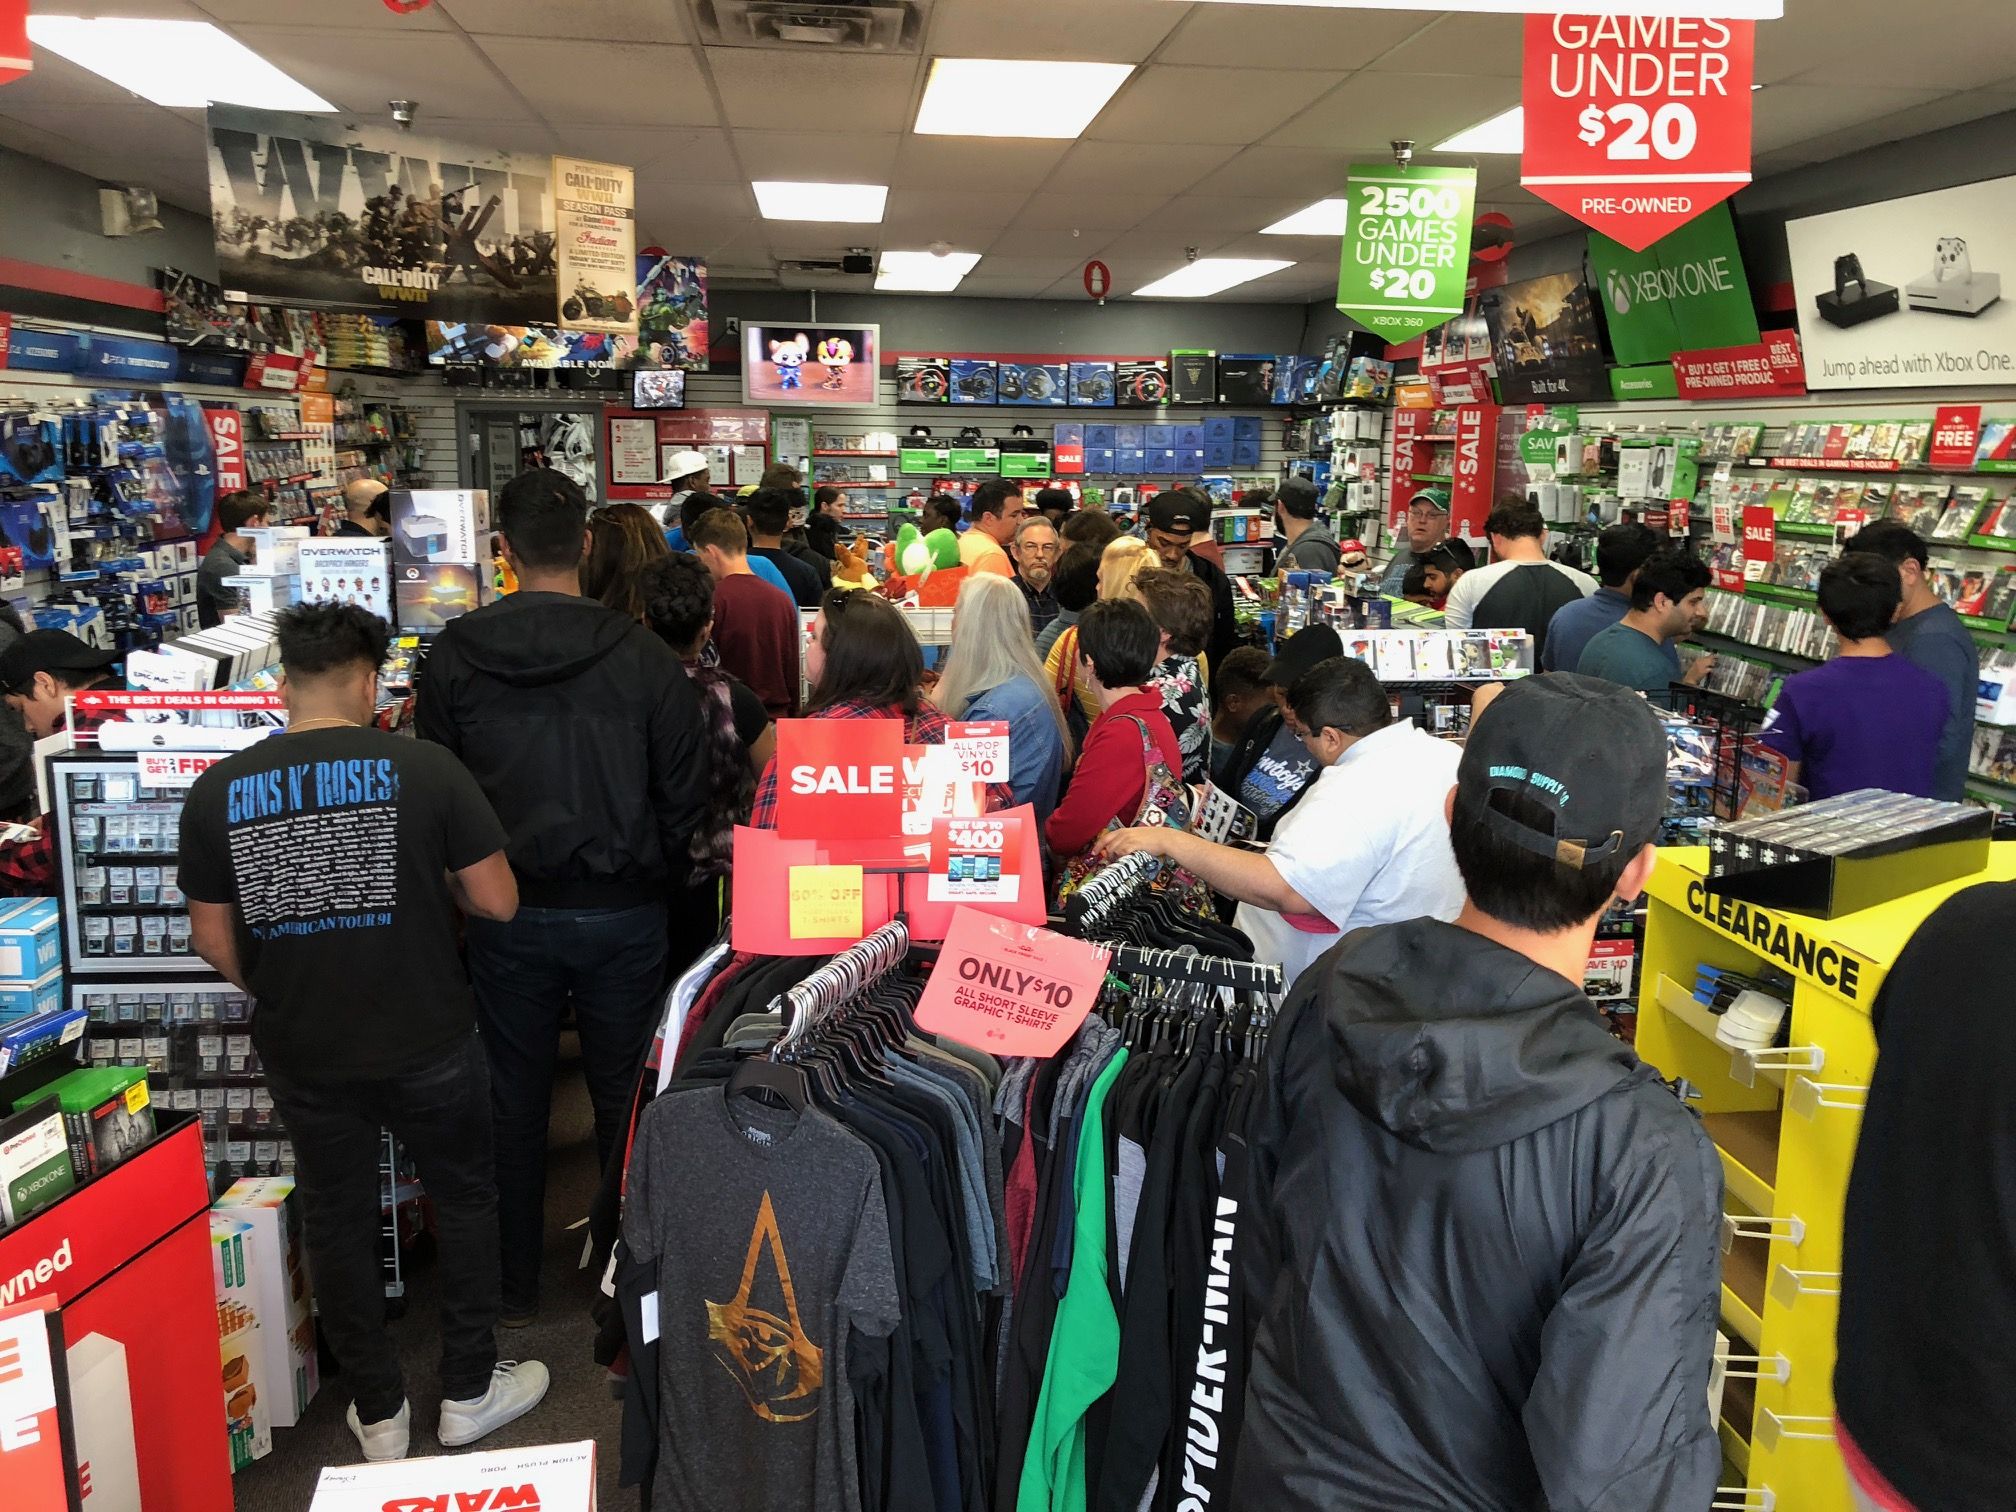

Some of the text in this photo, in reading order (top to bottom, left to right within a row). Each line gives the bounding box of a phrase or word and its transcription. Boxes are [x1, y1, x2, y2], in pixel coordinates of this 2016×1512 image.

[1552, 14, 1731, 49] GAMES
[1550, 52, 1729, 98] UNDER
[1577, 102, 1698, 160] $20
[565, 172, 623, 193] CALL DUTY
[562, 200, 627, 218] SEASON PASS
[1360, 186, 1461, 219] 2500
[1581, 197, 1692, 214] PRE-OWNED
[576, 230, 618, 246] Indian
[1358, 218, 1458, 244] GAMES
[1356, 241, 1457, 268] UNDER
[1369, 267, 1436, 300] $20
[1630, 256, 1734, 304] XBOX ONE
[1372, 316, 1424, 327] XBOX 360
[1769, 343, 1791, 354] BEST
[1771, 353, 1798, 366] DEALS
[521, 358, 584, 369] AVAILABLE
[1688, 362, 1705, 376] BUY
[1706, 363, 1712, 374] 2
[1713, 361, 1730, 374] GET
[1732, 361, 1736, 372] 1
[1737, 359, 1760, 372] FREE
[1823, 350, 2015, 381] Jump ahead with Xbox One.
[1685, 374, 1734, 388] PRE-OWNED
[1396, 412, 1416, 471] SALE
[1459, 410, 1481, 475] SALE
[1935, 430, 1974, 447] FREE
[214, 416, 241, 490] SALE
[1058, 455, 1082, 463] SALE
[458, 493, 468, 559] OVERWATCH
[1745, 526, 1772, 542] SALE
[301, 548, 381, 556] OVERWATCH
[107, 695, 131, 704] THE
[132, 695, 162, 704] BEST
[164, 695, 202, 704] DEALS
[203, 695, 216, 704] IN
[218, 695, 265, 704] GAMING
[953, 741, 1000, 750] ALL POP
[957, 750, 998, 759] VINYLS
[171, 766, 176, 774] 1
[791, 765, 894, 794] SALE
[961, 760, 994, 776] $10
[1489, 765, 1528, 780] DIAMOND
[1530, 772, 1565, 795] SUPPLY
[227, 758, 392, 823] GUNS N' ROSES
[949, 821, 1004, 830] GET UP TO
[948, 829, 1004, 849] $400
[830, 888, 860, 901] OFF
[268, 917, 337, 940] AMERICAN
[337, 913, 376, 929] TOUR
[377, 912, 393, 926] 91
[37, 940, 57, 964] Wii
[1687, 880, 1860, 1000] CLEARANCE
[959, 957, 1073, 1009] ONLY $10
[954, 996, 1053, 1031] GRAPHIC T-SHIRTS
[955, 986, 1059, 1023] ALL SHORT SLEEVE
[27, 1164, 66, 1193] XBOX ONE
[1176, 1195, 1239, 1512] SPIDER-MAN
[480, 1454, 588, 1474] ACTION PLUSH PORG
[381, 1483, 542, 1512] WARS
